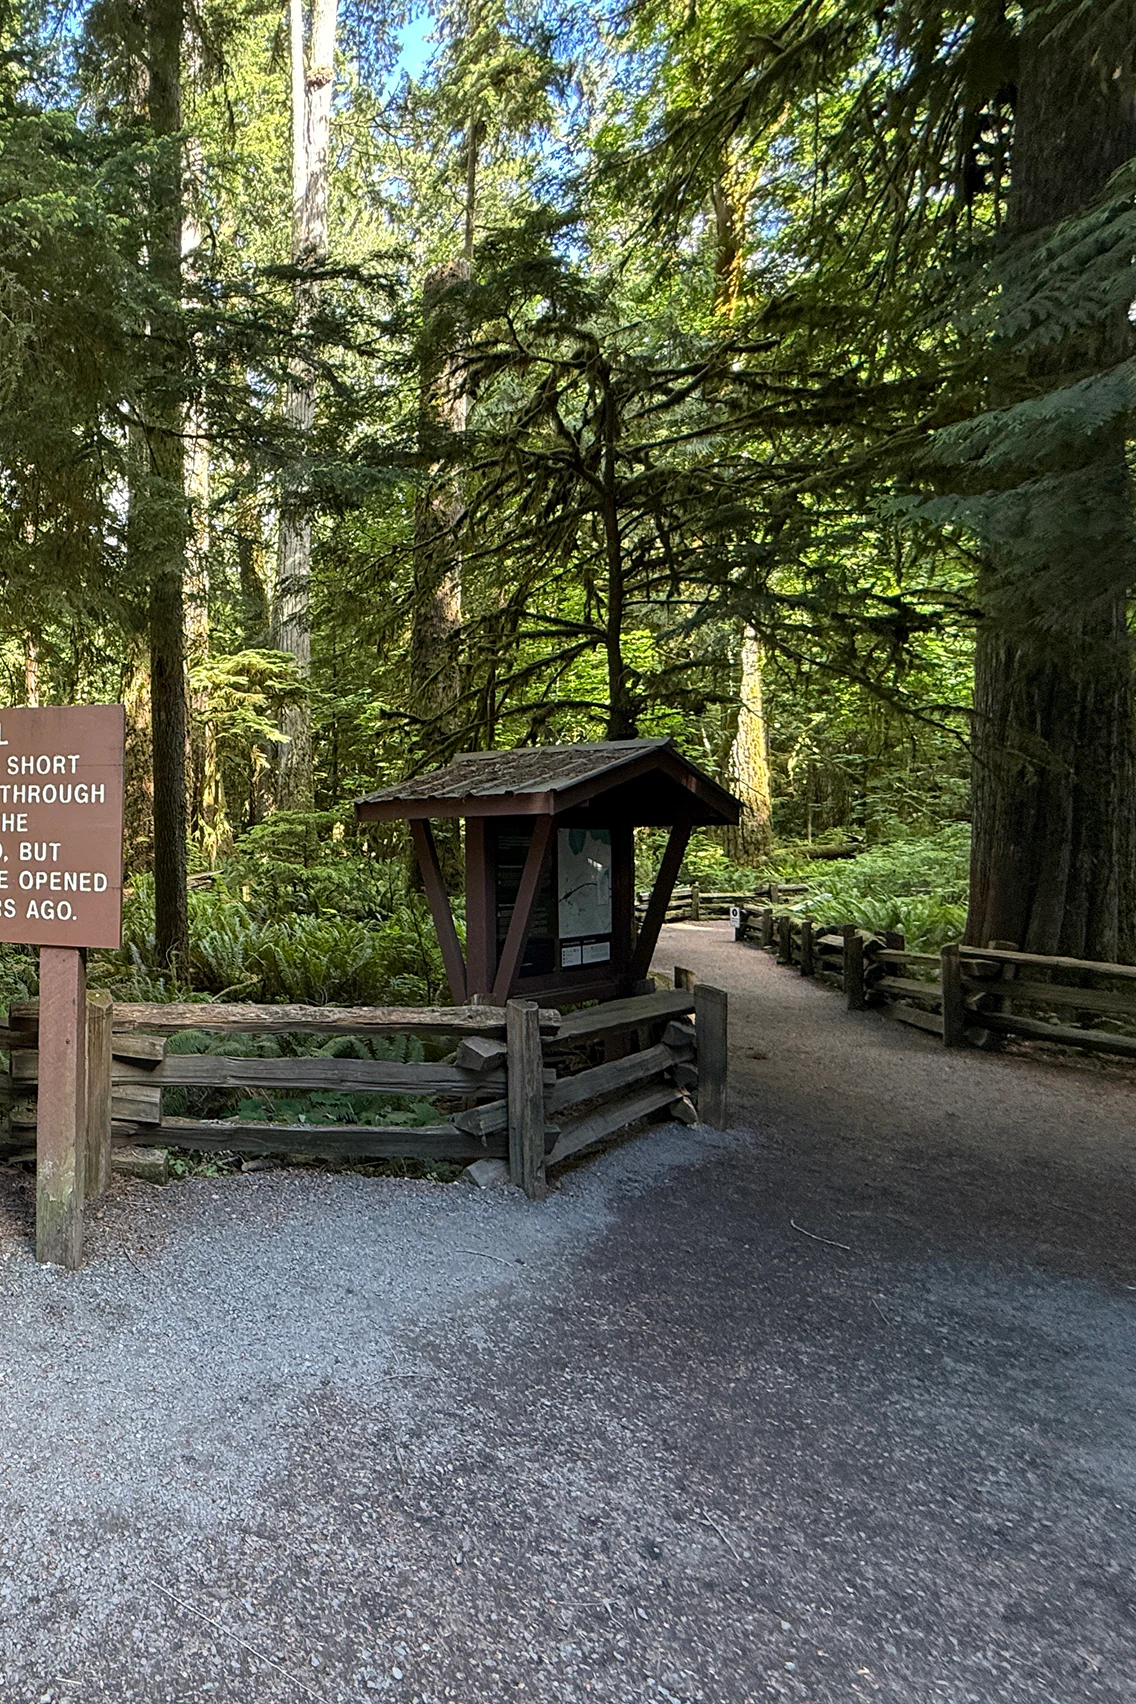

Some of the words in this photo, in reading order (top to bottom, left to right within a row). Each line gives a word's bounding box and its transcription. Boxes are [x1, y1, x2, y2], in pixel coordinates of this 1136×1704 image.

[6, 753, 80, 775] SHORT
[18, 841, 62, 862] BUT
[18, 869, 108, 892] OPENED
[25, 898, 77, 921] AGO.
